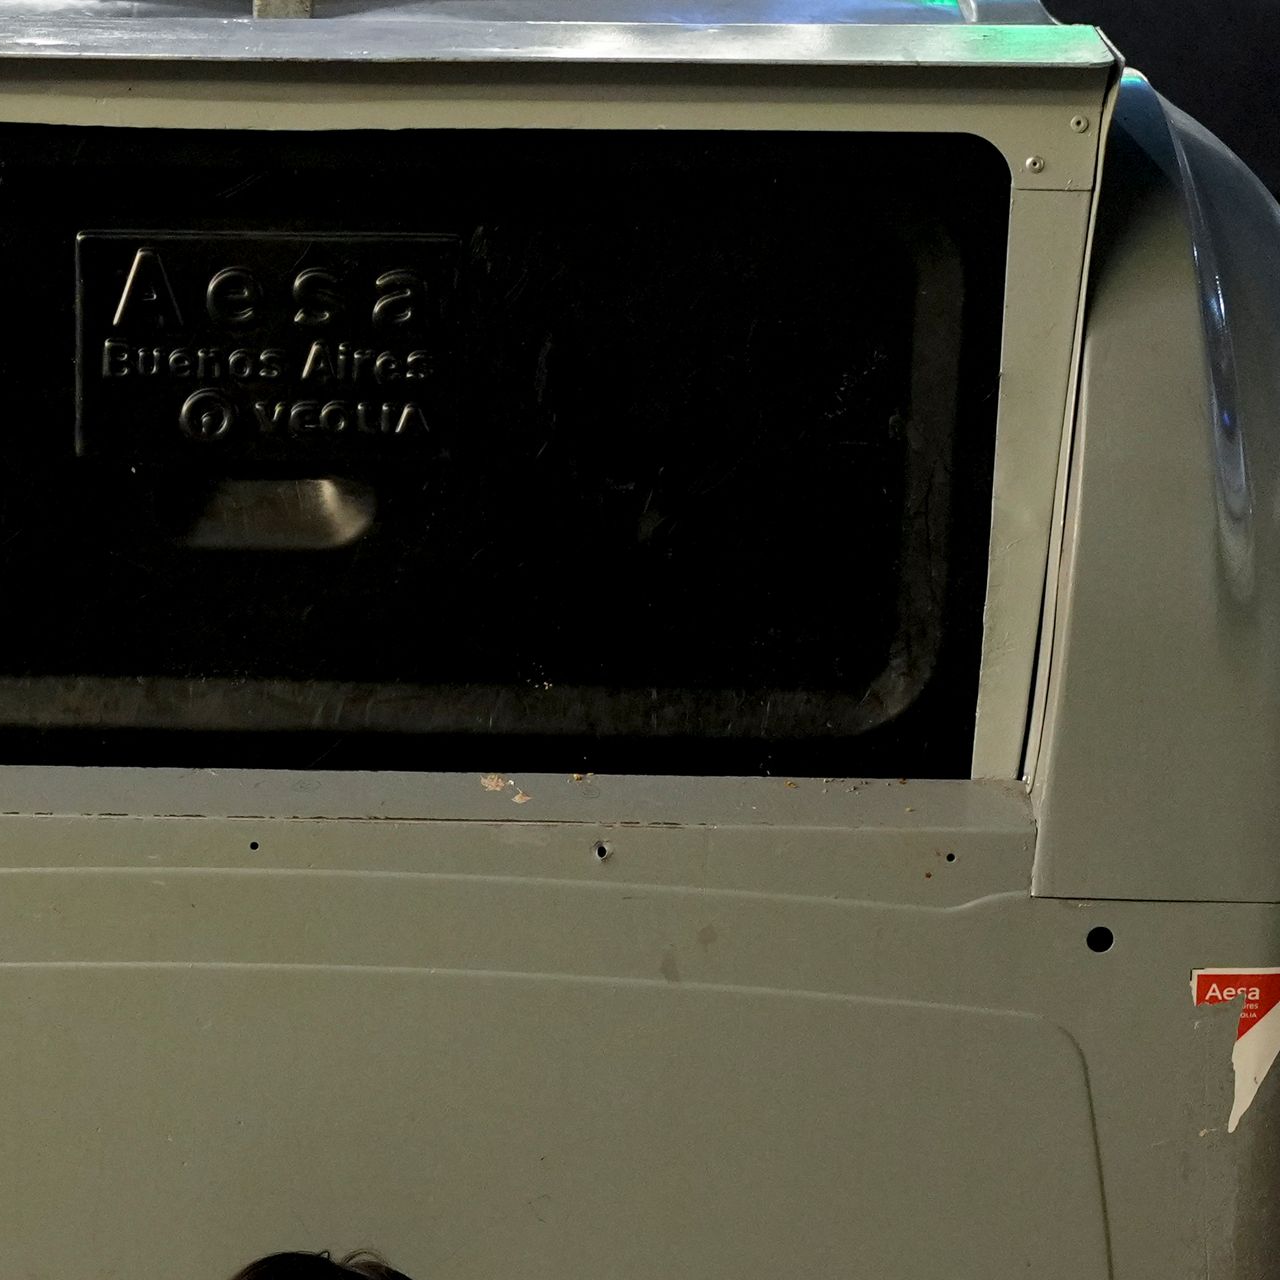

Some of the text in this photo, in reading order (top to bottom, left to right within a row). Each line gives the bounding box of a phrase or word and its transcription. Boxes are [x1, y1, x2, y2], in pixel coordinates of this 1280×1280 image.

[112, 246, 429, 326] Aesa
[102, 337, 435, 381] Buenos Aires
